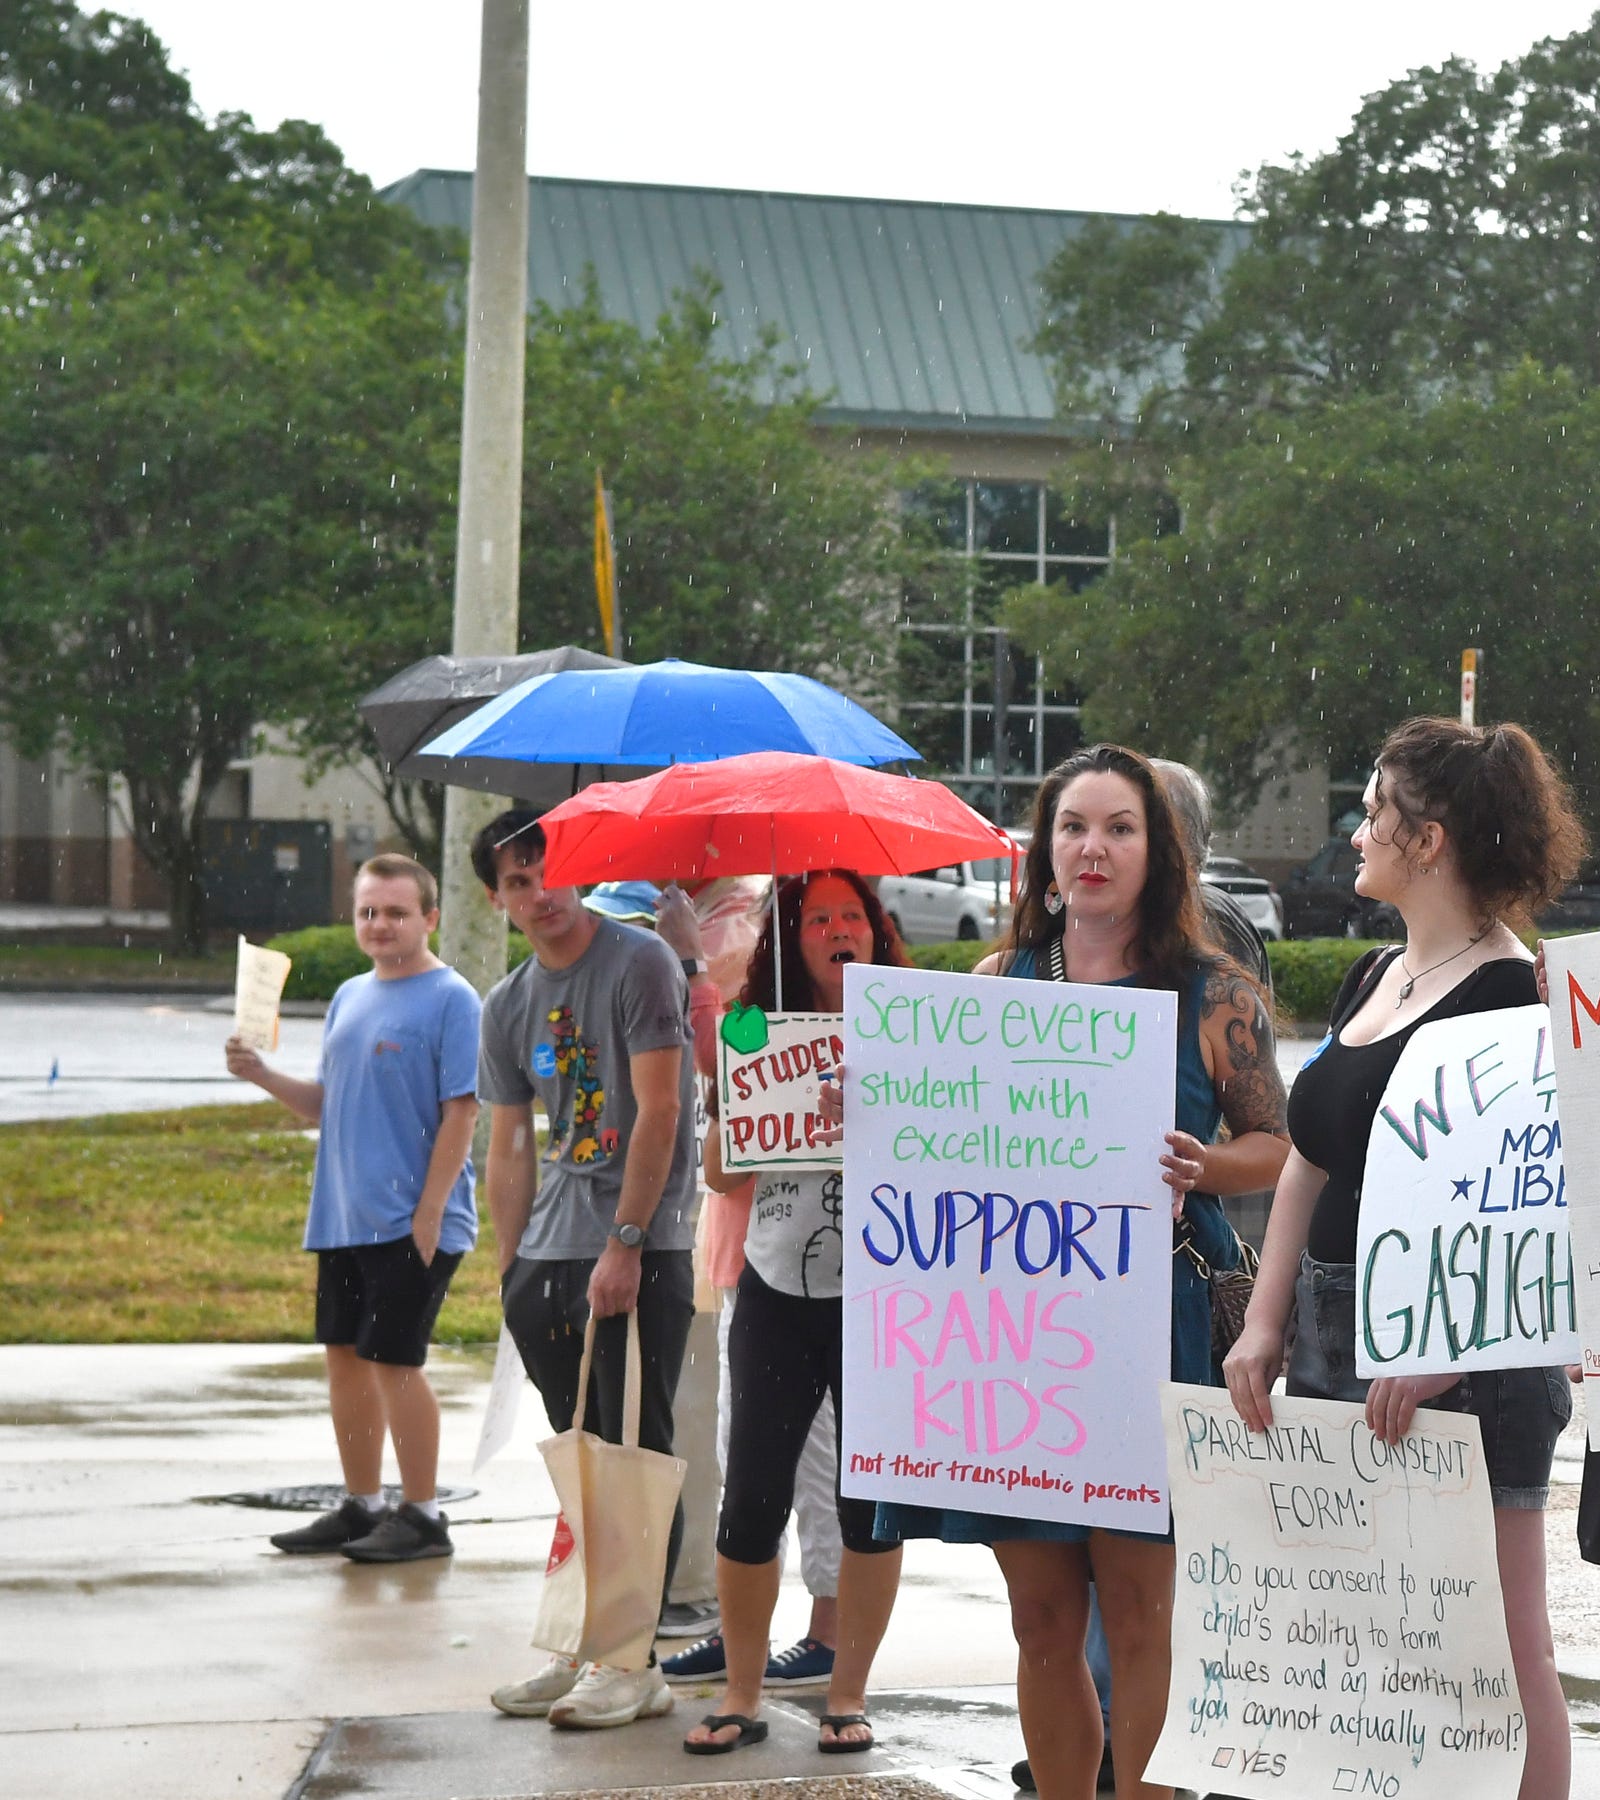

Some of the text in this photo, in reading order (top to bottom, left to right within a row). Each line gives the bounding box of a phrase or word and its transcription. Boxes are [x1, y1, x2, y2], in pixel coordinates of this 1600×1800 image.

[854, 982, 1138, 1061] Serve every
[731, 1034, 843, 1101] STUDEN
[860, 1065, 991, 1113] student
[1008, 1077, 1090, 1119] with
[757, 1203, 792, 1225] hugs
[862, 1183, 1153, 1282] SUPPORT
[850, 1280, 1096, 1371] TRANS
[1363, 1221, 1577, 1363] GASLIGH
[913, 1370, 1088, 1456] KIDS
[1183, 1407, 1470, 1483] PARENTAL CONSENT
[850, 1452, 1162, 1504] not their transphobic parents
[1269, 1482, 1369, 1533] FORM:
[1211, 1546, 1242, 1585] Do
[1254, 1565, 1296, 1611] you
[1308, 1559, 1388, 1596] consent
[1398, 1562, 1417, 1597] to
[1430, 1577, 1477, 1622] your
[1203, 1599, 1442, 1667] child's ability to form
[1200, 1650, 1510, 1708] values and an identity that
[1190, 1697, 1524, 1764] you cannot actually control?
[1241, 1748, 1288, 1778] YES
[1364, 1767, 1401, 1799] NO
